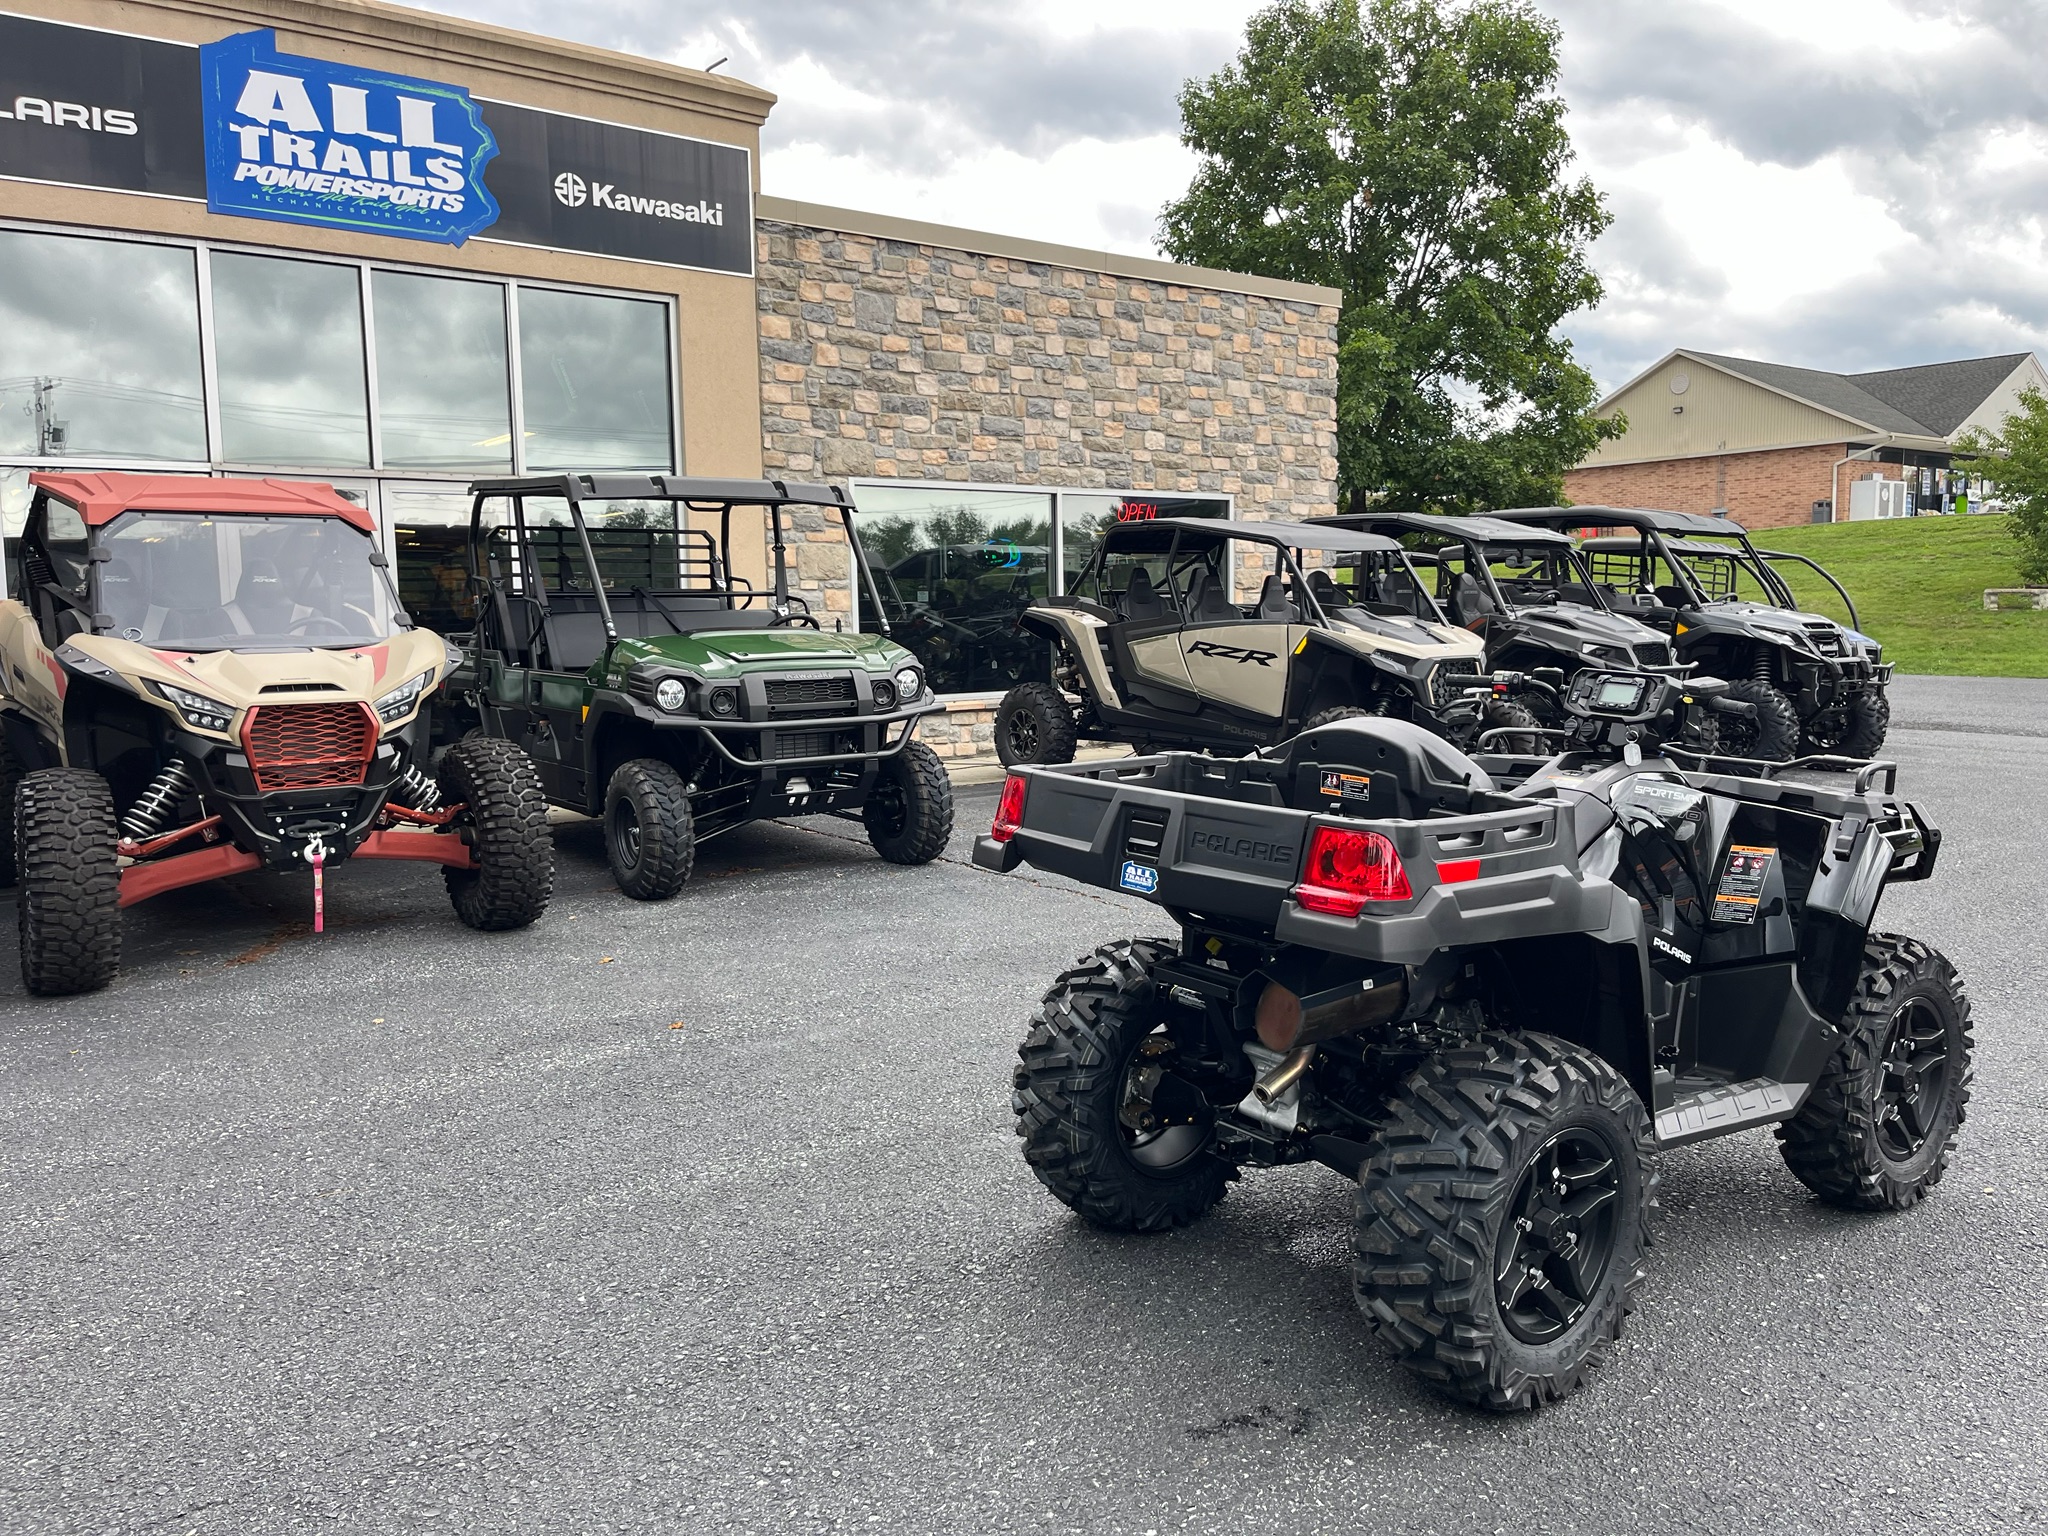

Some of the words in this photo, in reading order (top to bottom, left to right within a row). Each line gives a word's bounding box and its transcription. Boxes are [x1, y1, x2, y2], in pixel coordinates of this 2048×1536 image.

[0, 96, 138, 135] ARIS
[235, 69, 463, 159] ALL
[229, 122, 465, 191] TRAILS
[233, 162, 465, 213] POWERSPORTS
[592, 182, 723, 226] Kawasaki
[1118, 502, 1157, 522] OPEN
[1186, 640, 1279, 668] RZR
[1223, 724, 1267, 741] POLARIS
[1634, 784, 1702, 805] SPORTSMAN
[1191, 831, 1294, 865] POLARIS
[1126, 866, 1153, 879] ALL
[1653, 936, 1692, 965] POLARIS
